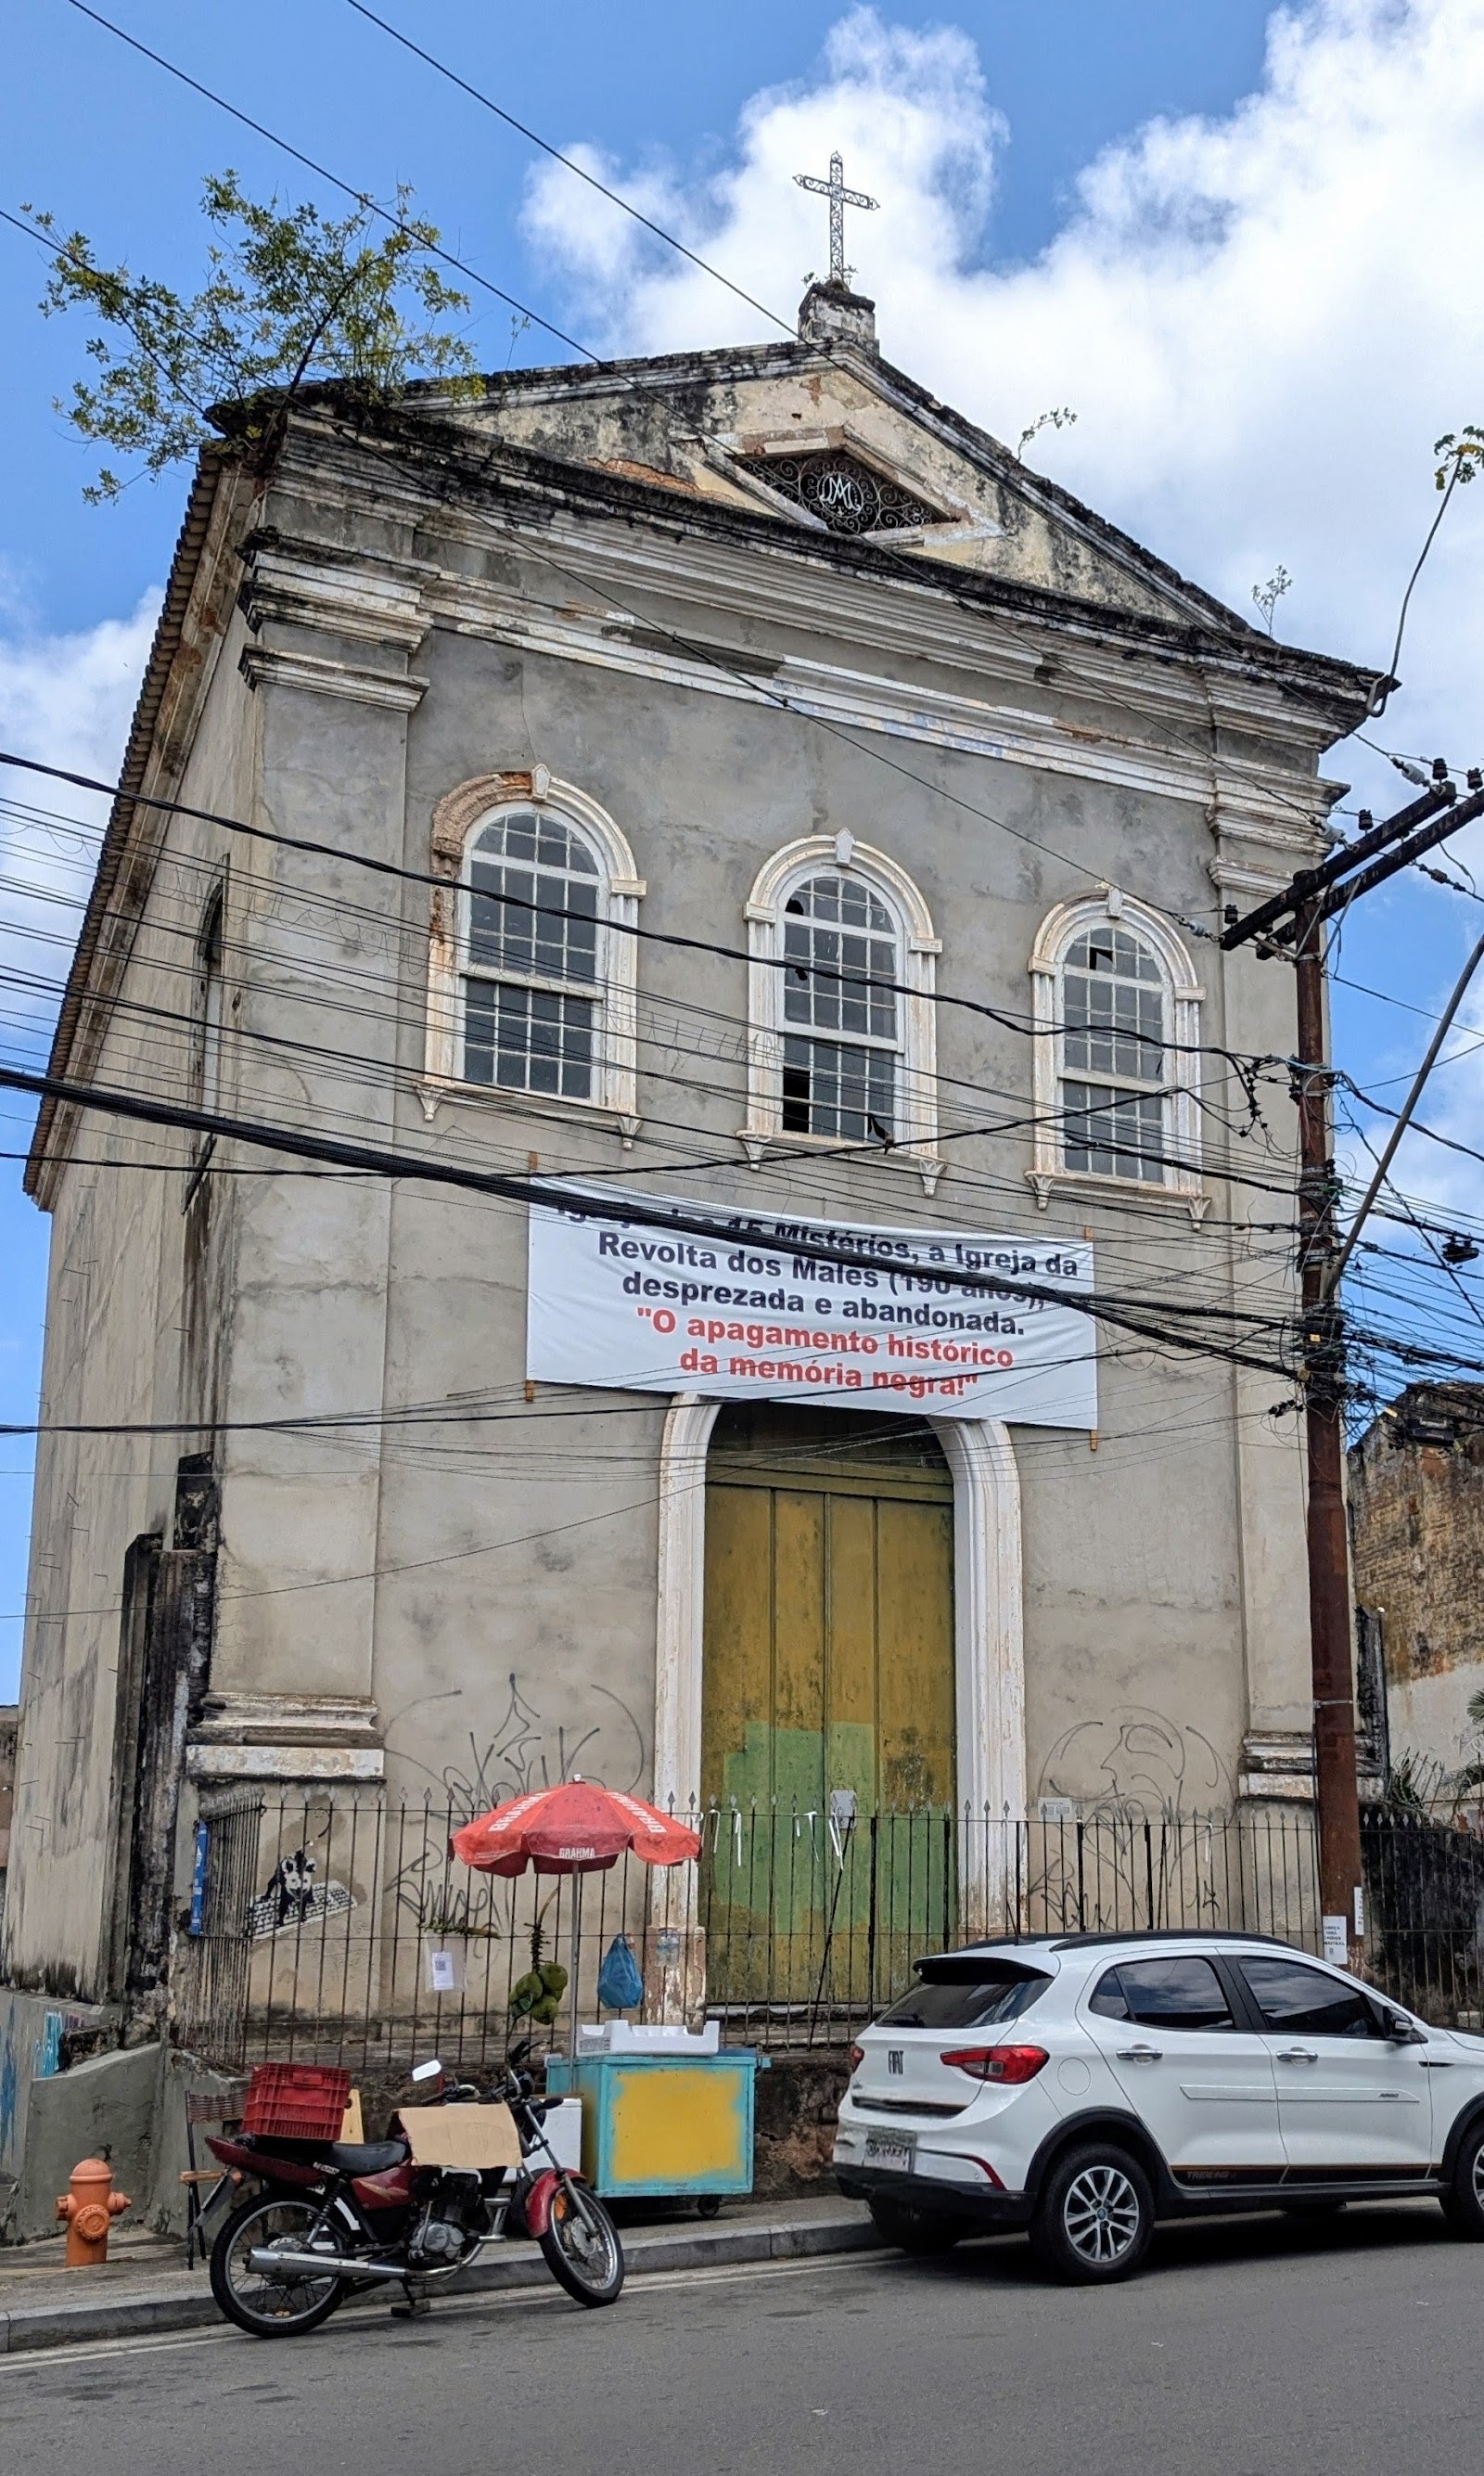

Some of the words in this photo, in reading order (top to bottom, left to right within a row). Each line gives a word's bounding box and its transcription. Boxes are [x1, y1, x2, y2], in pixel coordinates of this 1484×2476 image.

[599, 1232, 717, 1269] Revolta
[727, 1250, 781, 1276] dos
[929, 1245, 945, 1262] a
[955, 1244, 1036, 1275] Igreja
[1045, 1253, 1078, 1276] da
[622, 1271, 804, 1312] desprezada
[814, 1296, 832, 1315] e
[842, 1297, 1024, 1336] abandonada.
[636, 1306, 676, 1333] "O
[687, 1317, 878, 1354] apagamento
[888, 1333, 1013, 1367] histórico
[680, 1348, 718, 1373] da
[729, 1357, 862, 1387] memória
[873, 1371, 978, 1399] negra!"
[488, 1791, 553, 1832] BRAHMA
[558, 1847, 595, 1860] BRAHMA
[888, 2050, 904, 2075] FIAT
